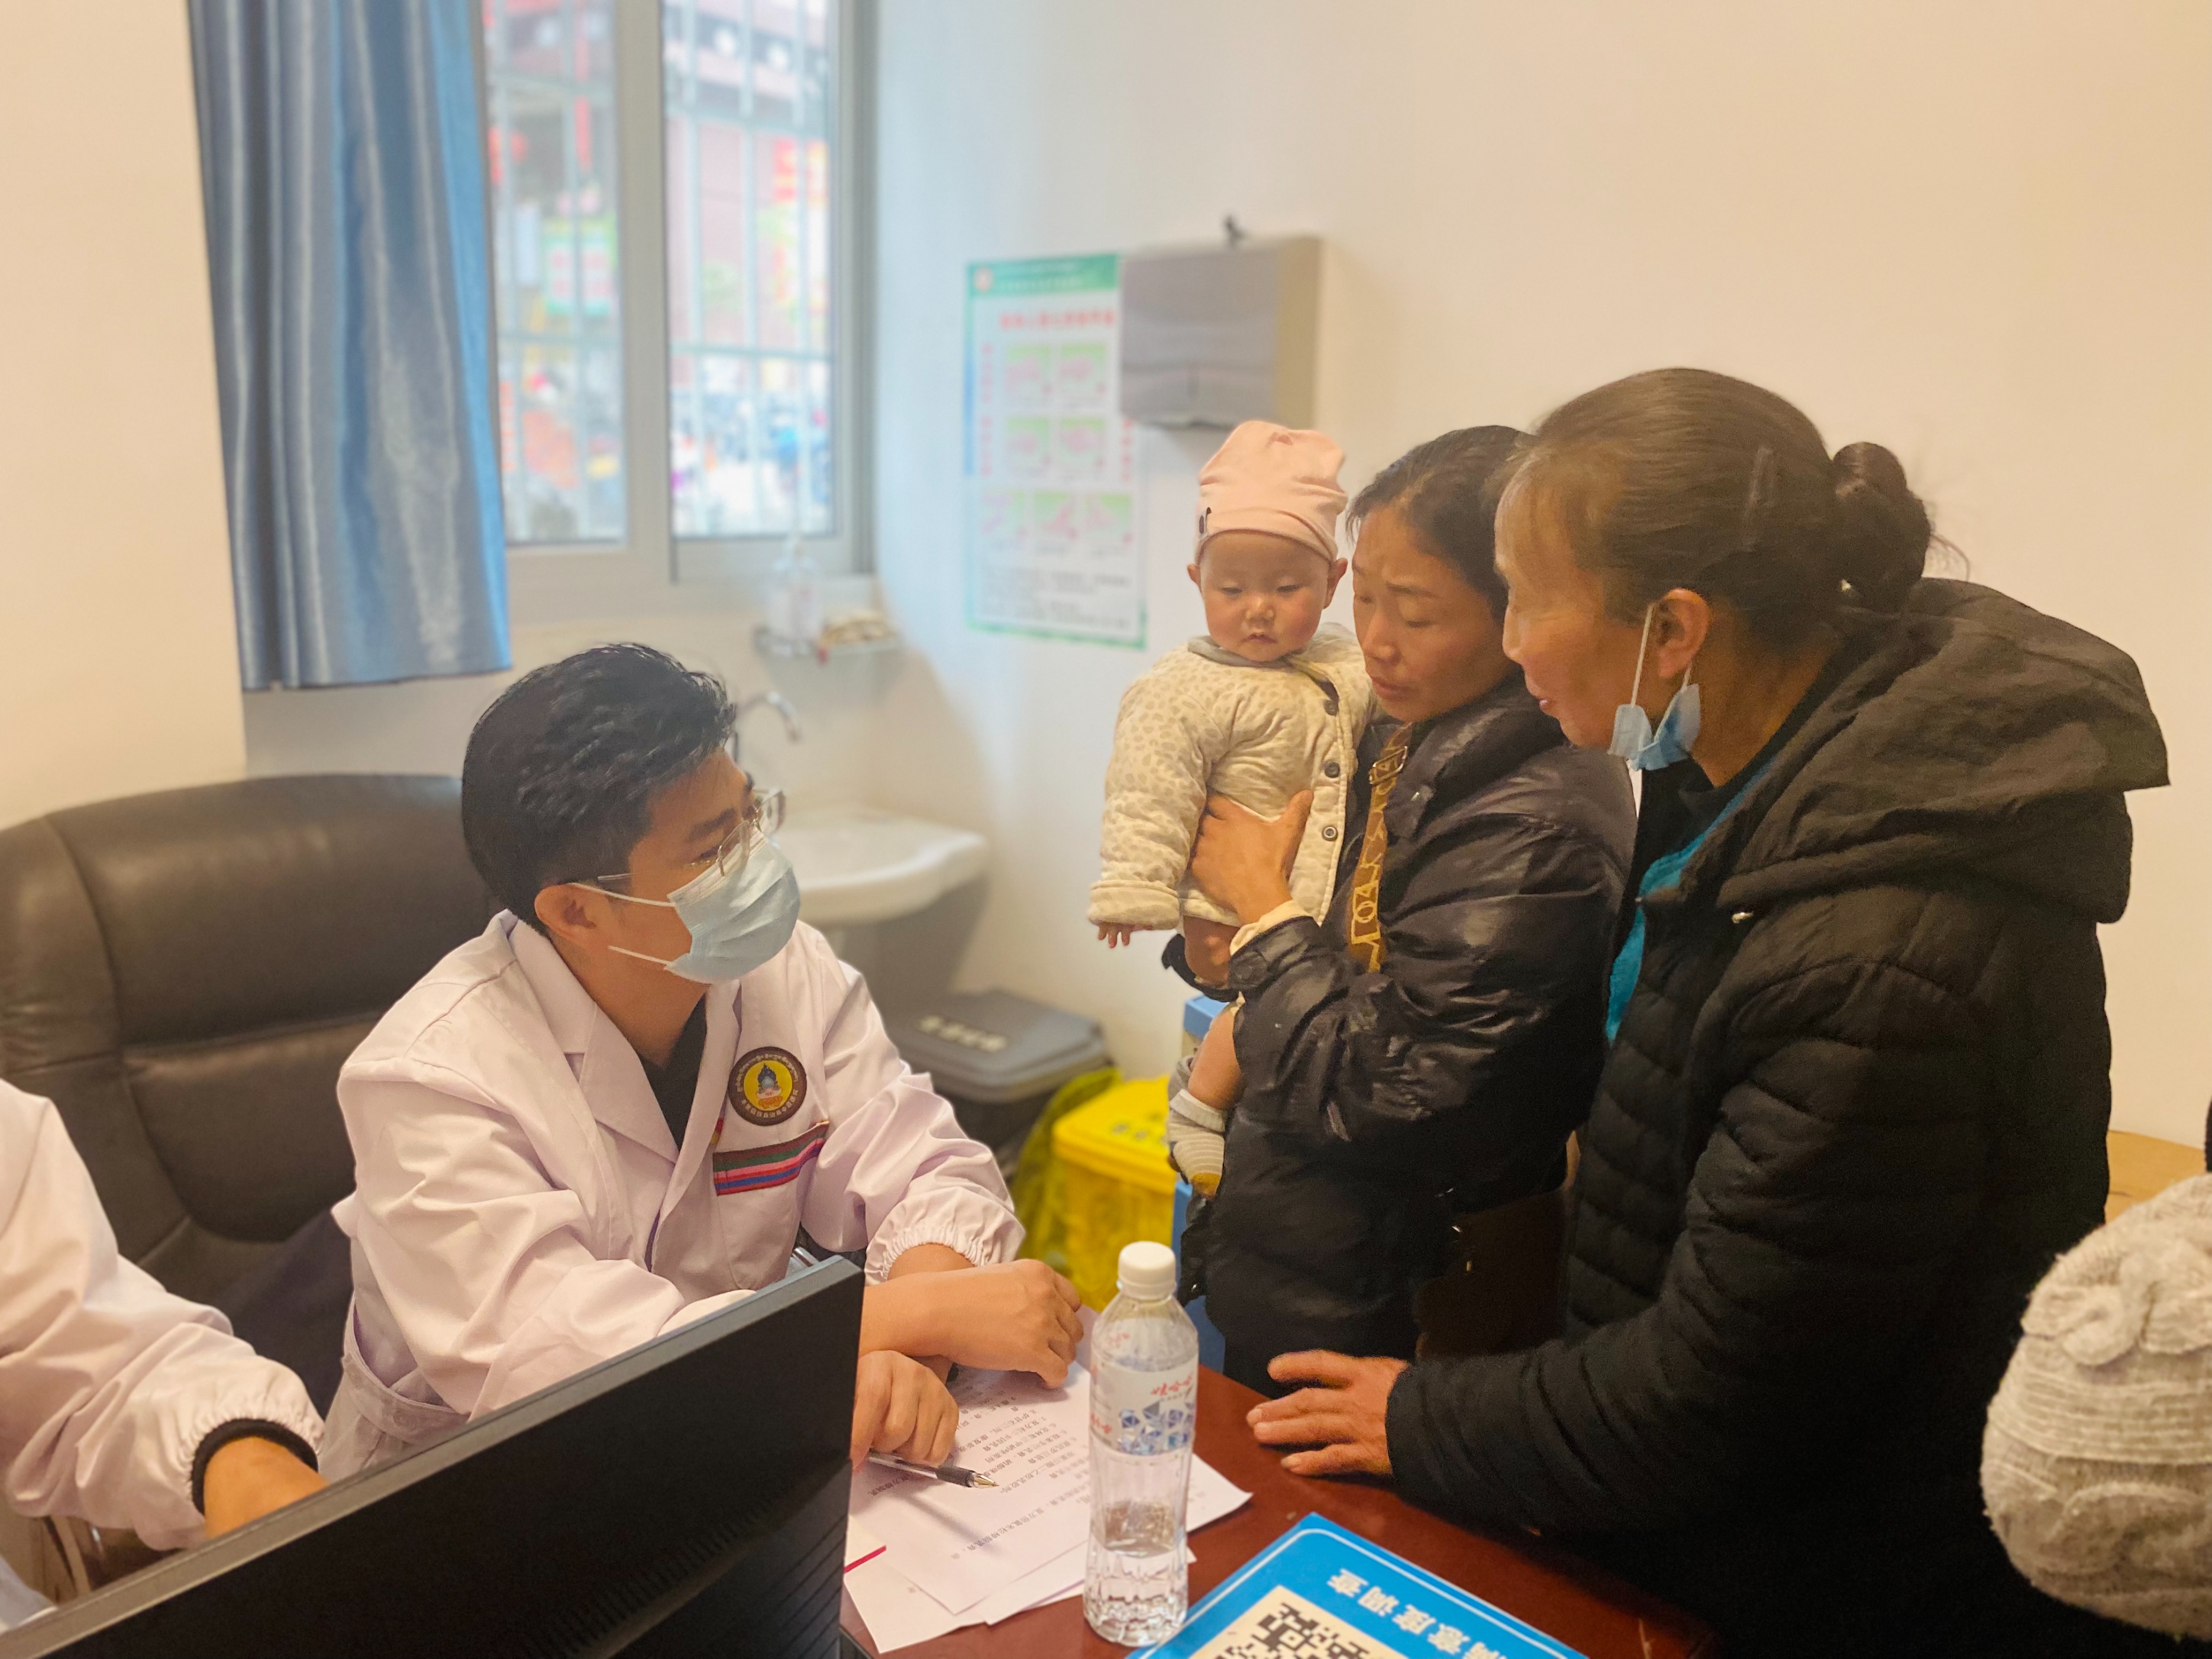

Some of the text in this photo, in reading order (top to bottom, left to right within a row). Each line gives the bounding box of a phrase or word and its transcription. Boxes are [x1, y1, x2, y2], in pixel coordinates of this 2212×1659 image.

[1327, 1568, 1509, 1659] 满意度调查
